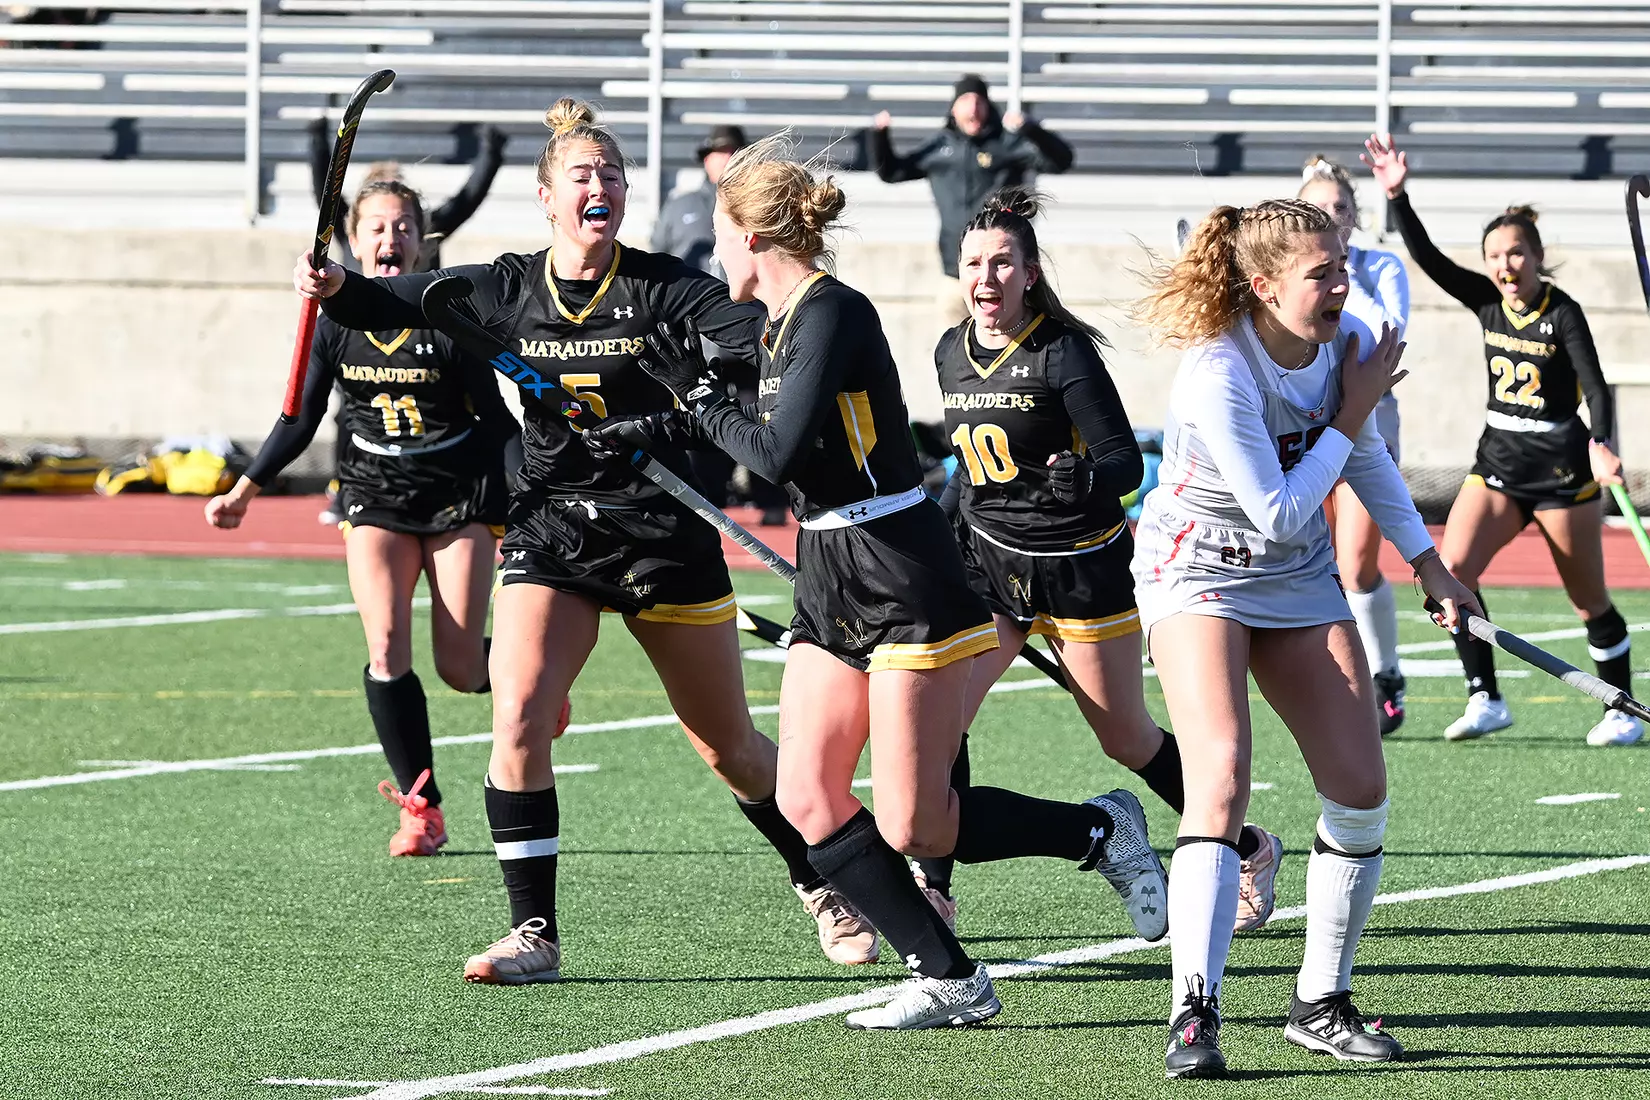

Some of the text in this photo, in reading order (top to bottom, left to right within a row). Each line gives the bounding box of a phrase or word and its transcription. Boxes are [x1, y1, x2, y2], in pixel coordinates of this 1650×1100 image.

[519, 338, 645, 360] MARAUDERS
[340, 363, 441, 383] MARAUDERS
[489, 351, 555, 399] STX
[1490, 356, 1545, 409] 22
[370, 393, 425, 437] 11
[559, 373, 608, 433] 5
[951, 423, 1019, 486] 10
[1221, 547, 1251, 568] 23
